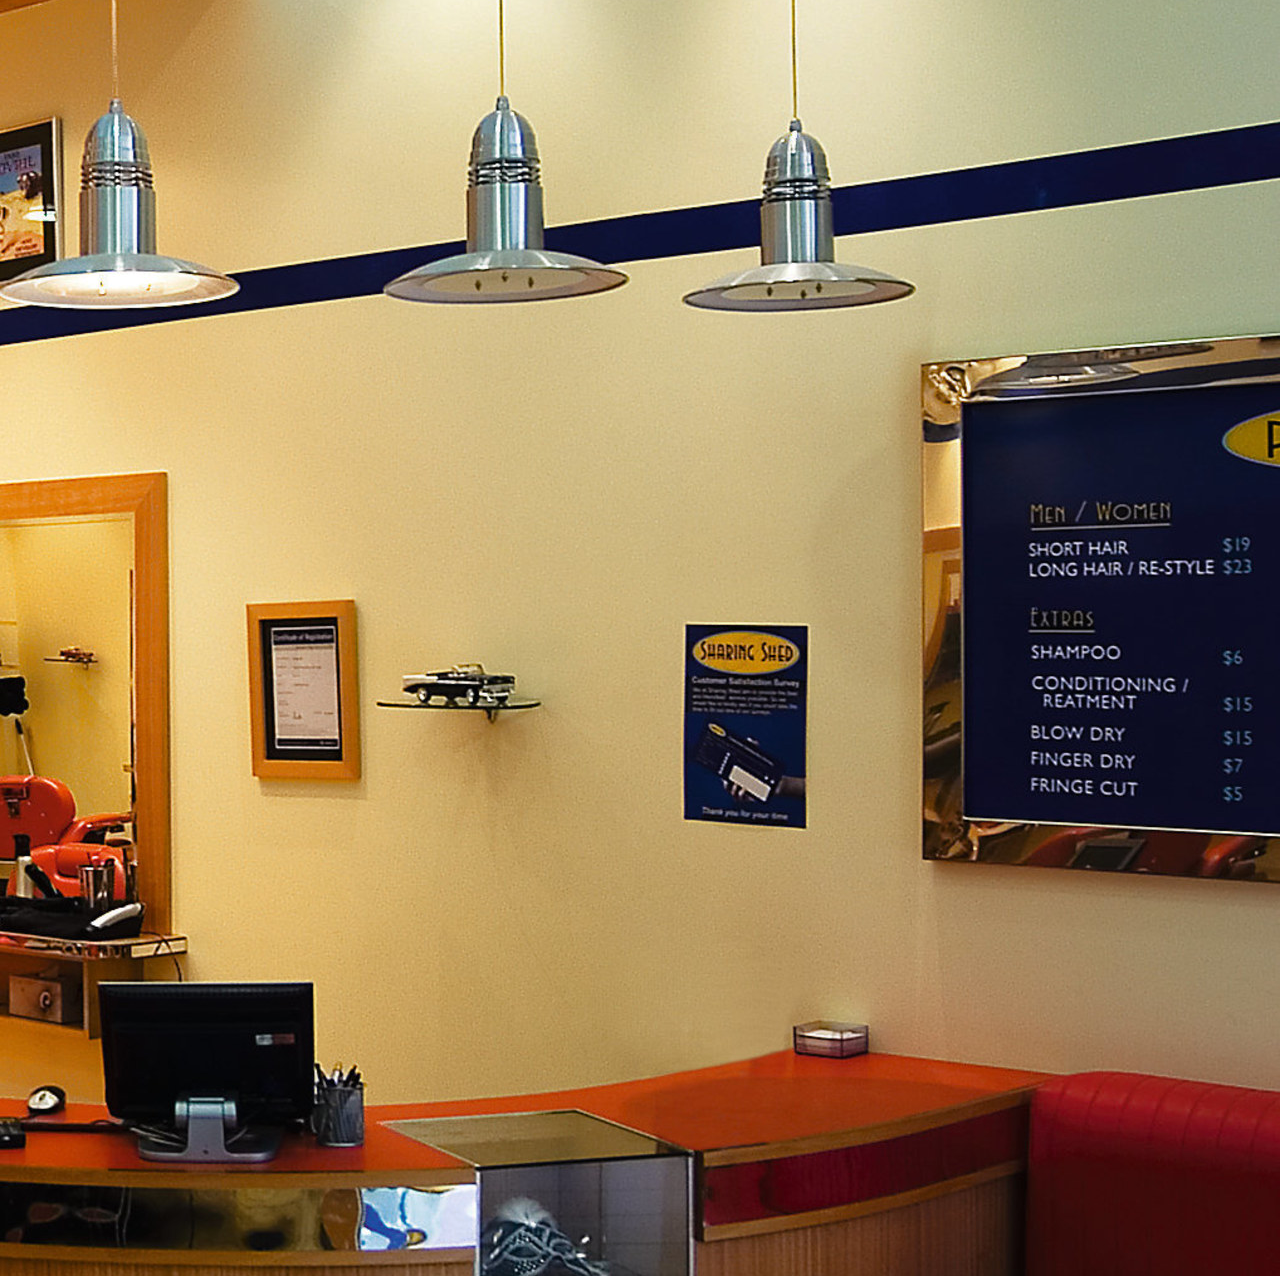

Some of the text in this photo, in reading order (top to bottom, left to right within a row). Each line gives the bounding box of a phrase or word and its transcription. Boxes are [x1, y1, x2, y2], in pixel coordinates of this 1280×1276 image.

[1028, 537, 1251, 557] SHORT HAIR $19
[1028, 559, 1252, 577] LONG HAIR / RE-STYLE $23
[1030, 607, 1094, 627] EXTRAS
[700, 640, 793, 662] SHARING SHED
[1030, 644, 1244, 666] SHAMPOO $6
[1031, 676, 1190, 693] CONDITIONING /
[1043, 694, 1253, 713] REATMENT $15
[1030, 725, 1253, 746] BLOW DRY $15
[1030, 751, 1244, 774] FINGER DRY $7
[1030, 777, 1244, 802] FRINGE CUT $5
